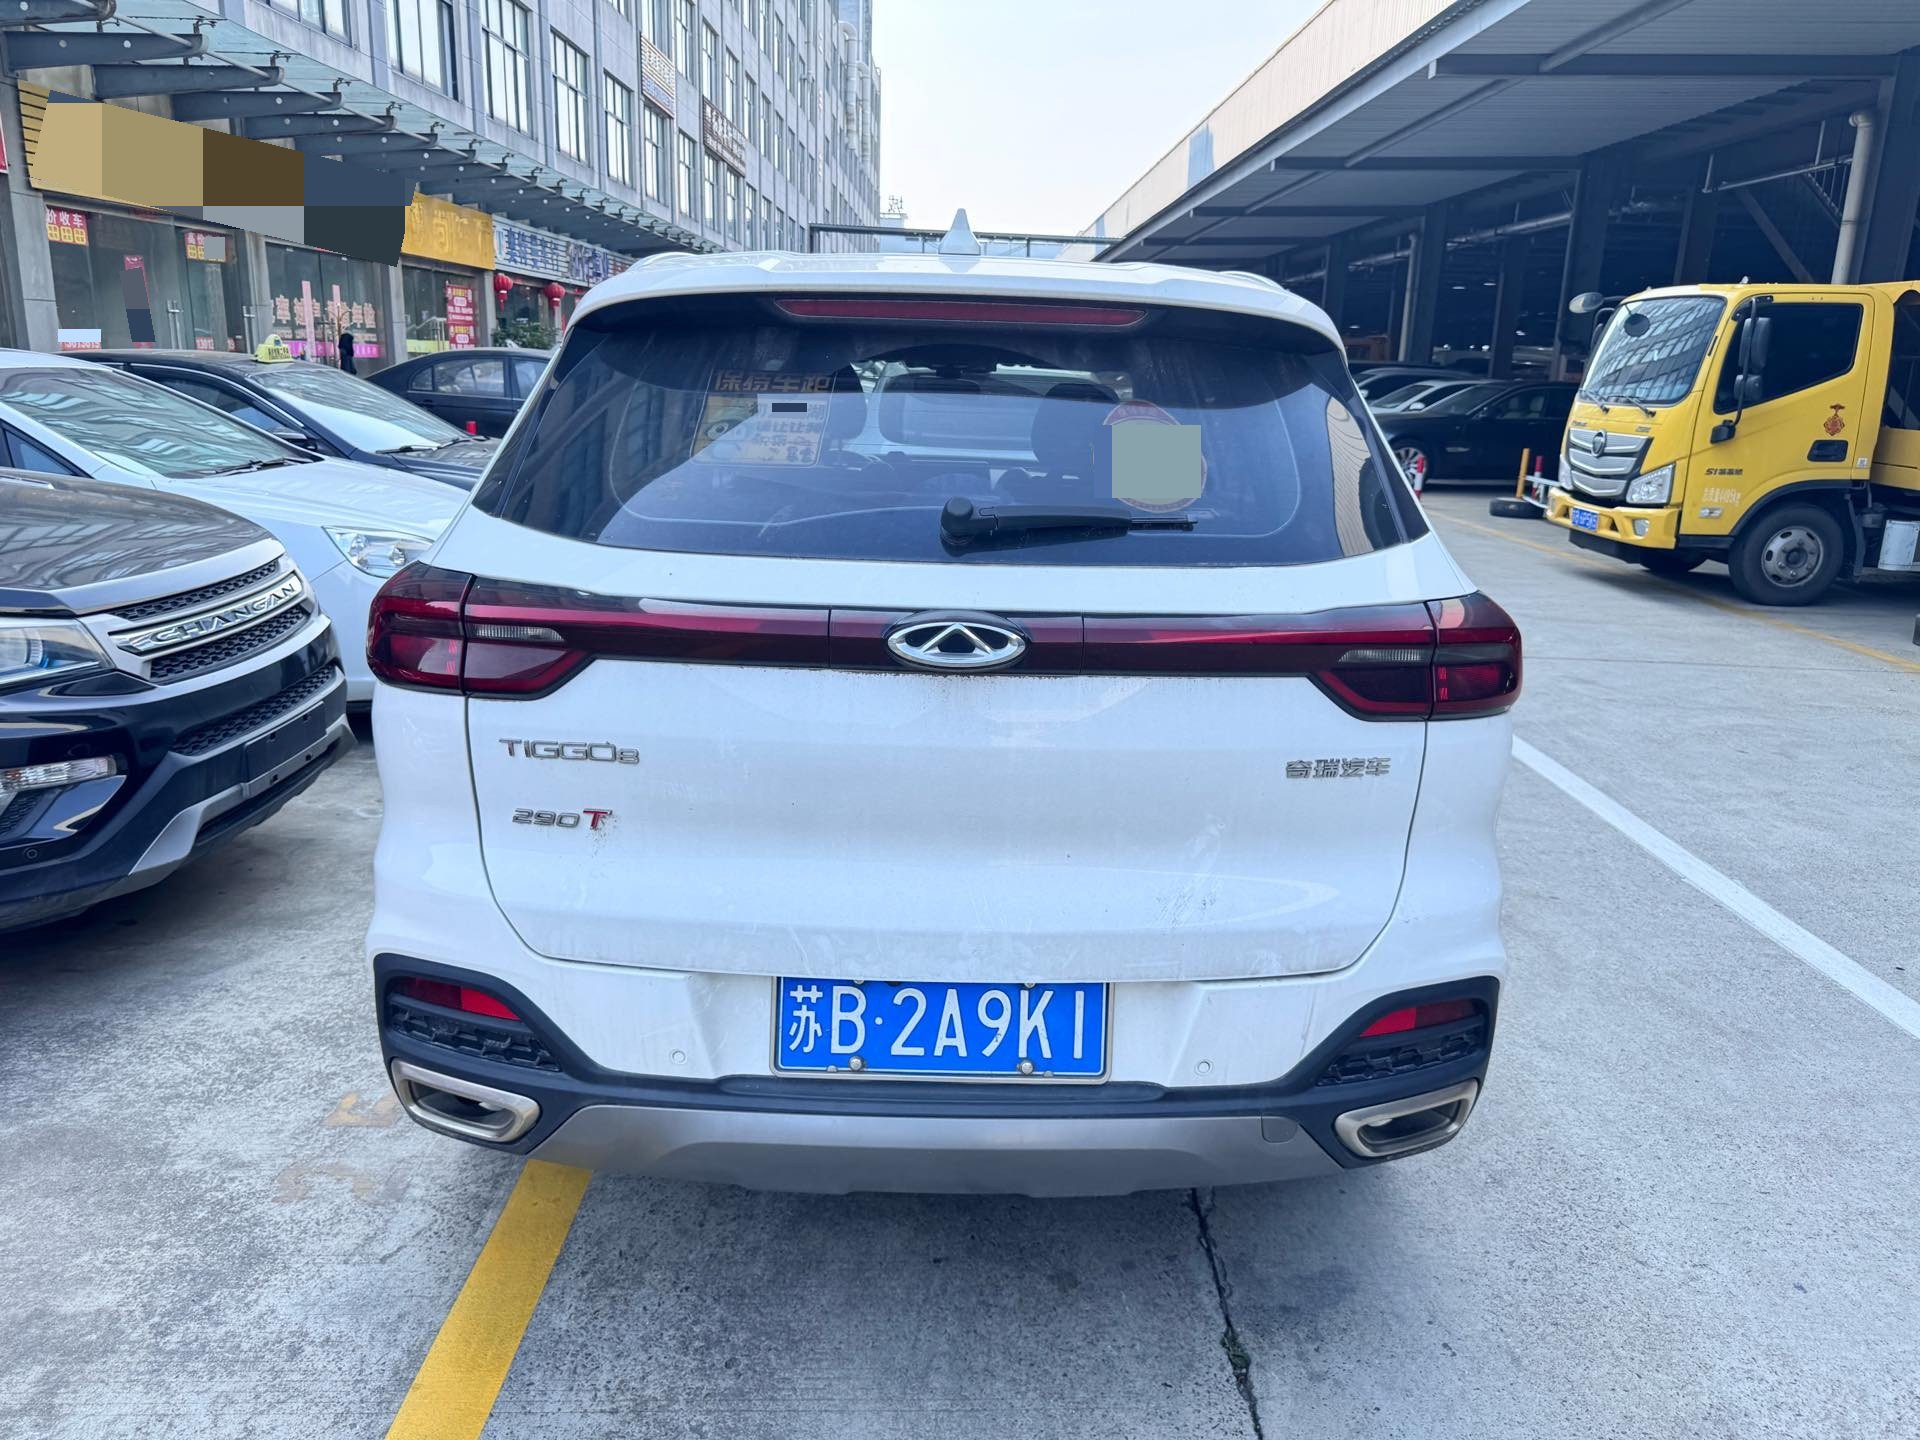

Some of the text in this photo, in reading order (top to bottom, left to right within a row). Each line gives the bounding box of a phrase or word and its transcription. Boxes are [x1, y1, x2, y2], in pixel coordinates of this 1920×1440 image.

[150, 582, 297, 646] CHANGAN
[1285, 756, 1392, 779] 奇瑞汽车
[512, 807, 613, 831] 290T
